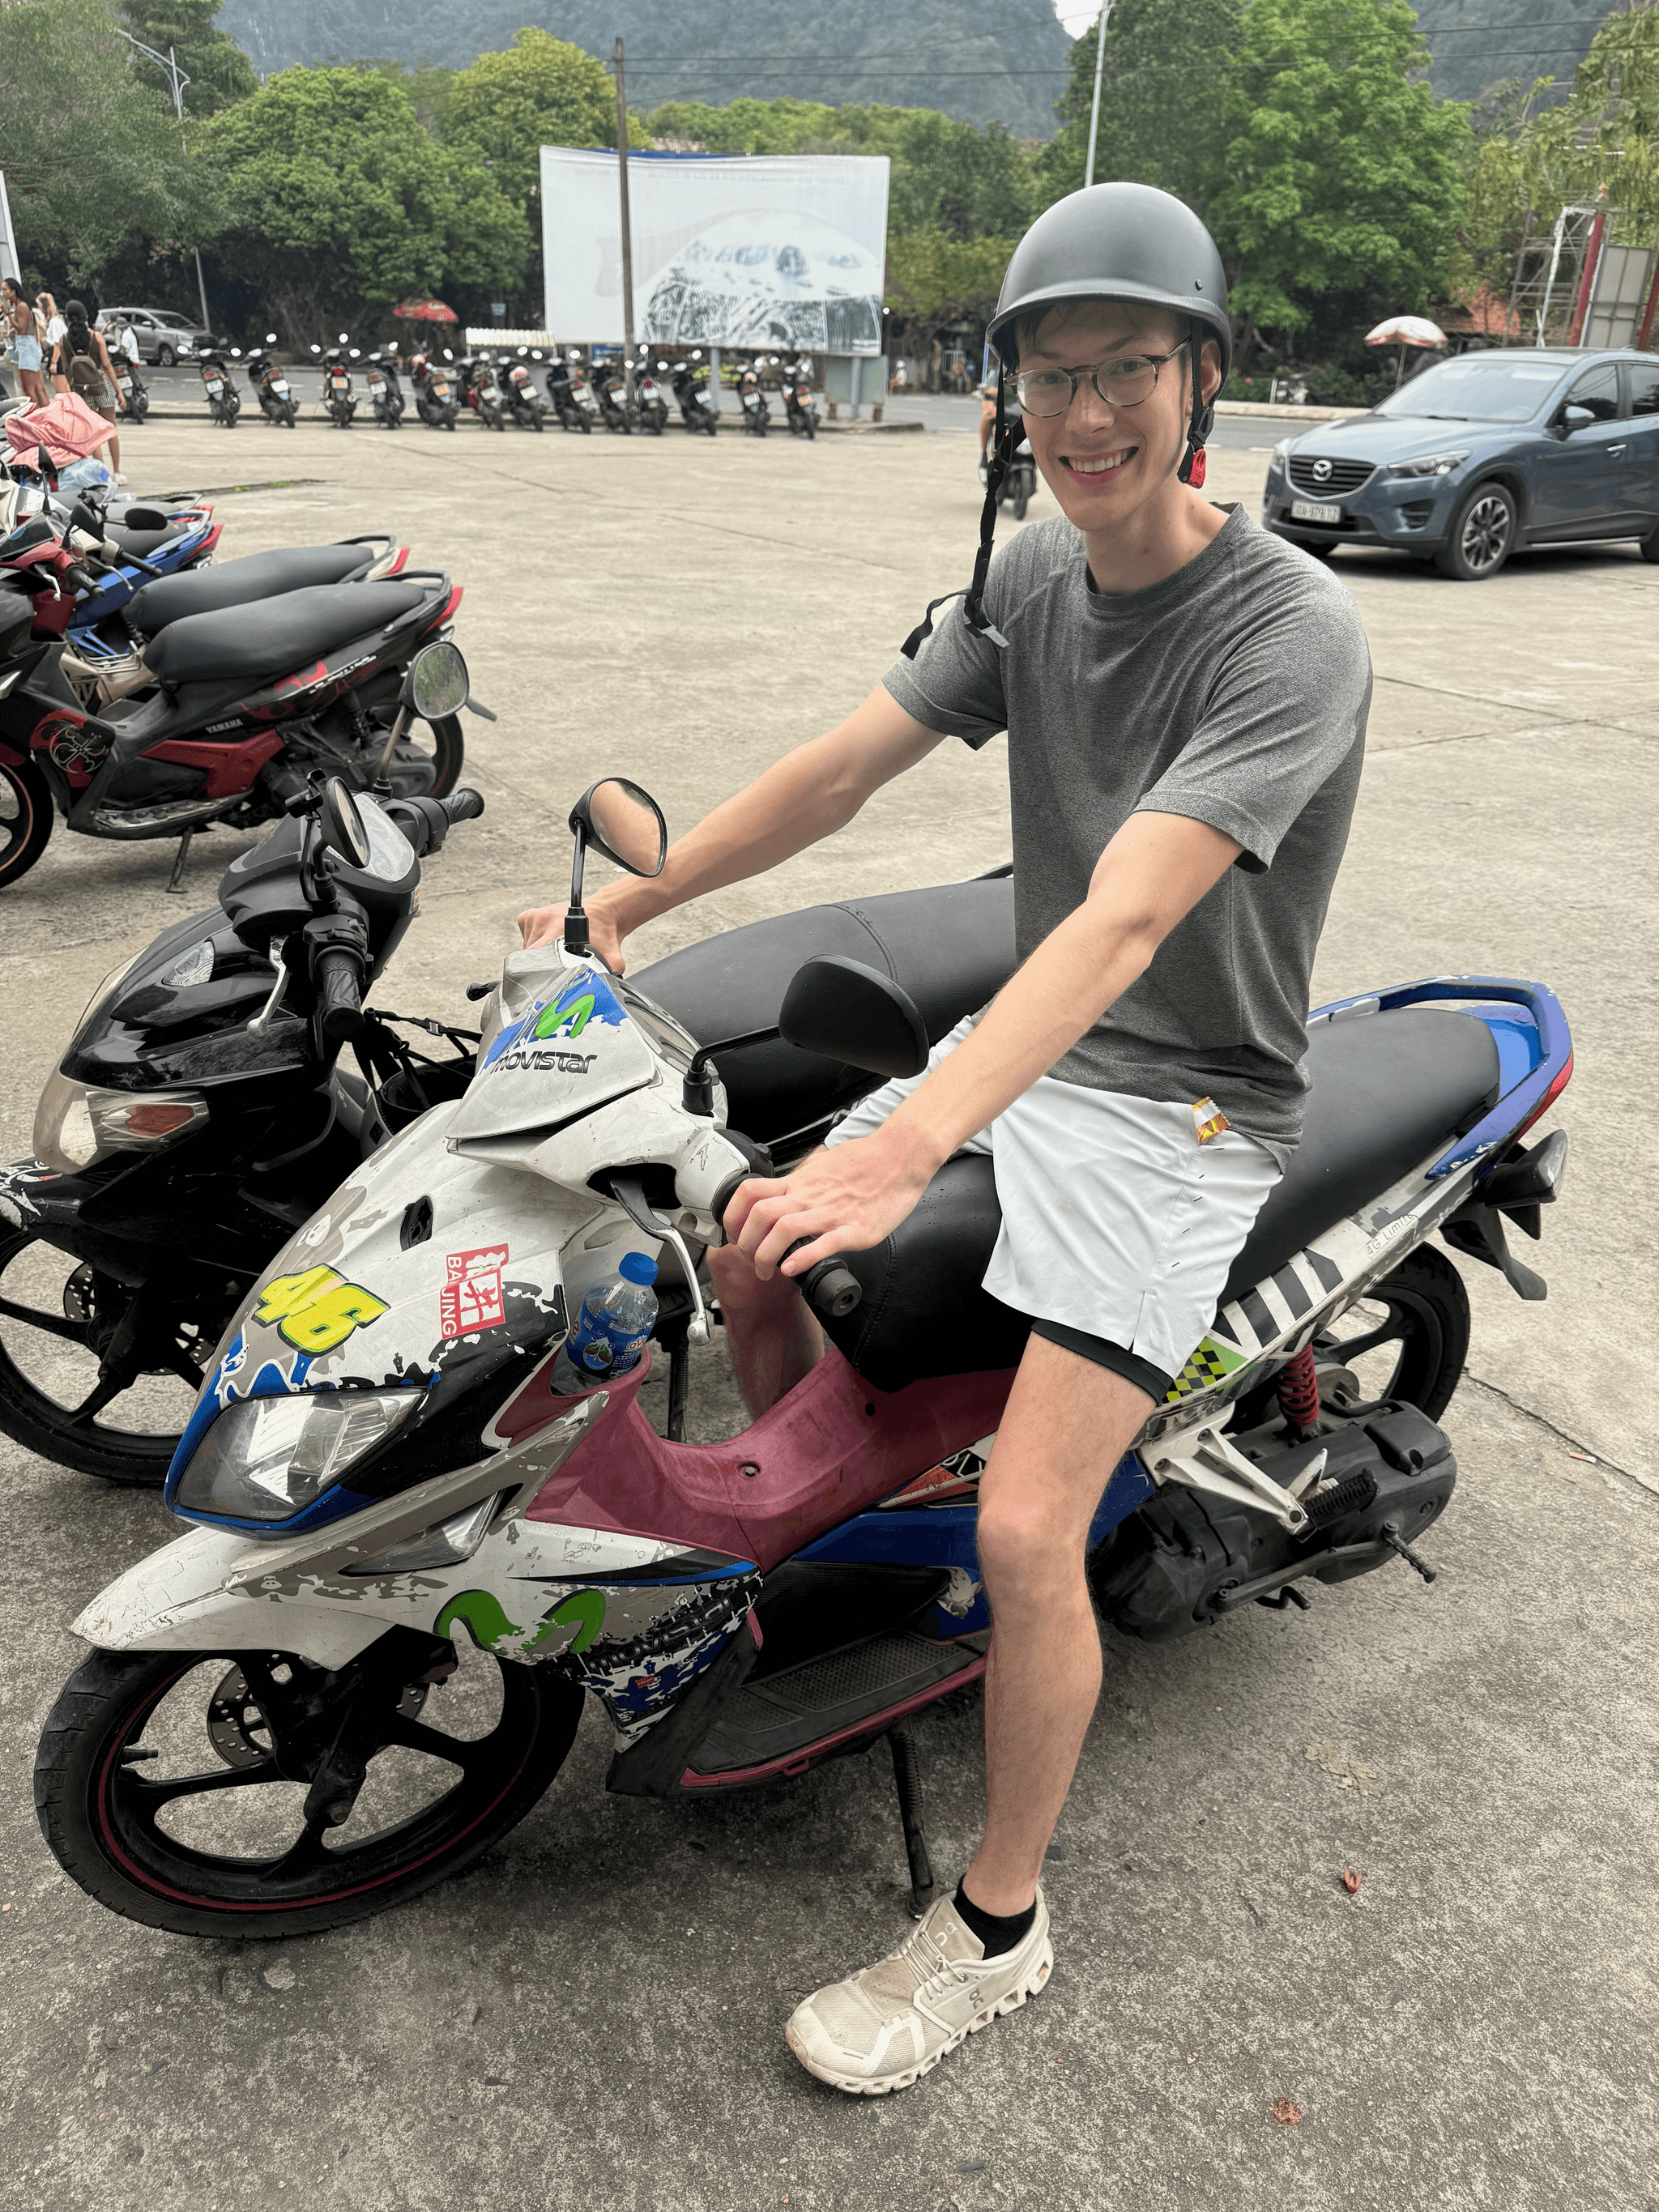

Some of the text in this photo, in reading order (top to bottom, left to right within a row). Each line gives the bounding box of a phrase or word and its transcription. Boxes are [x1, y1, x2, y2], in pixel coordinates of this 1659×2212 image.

[205, 718, 244, 734] YAMAHA
[1367, 1238, 1381, 1255] 4G
[251, 1263, 391, 1358] 46
